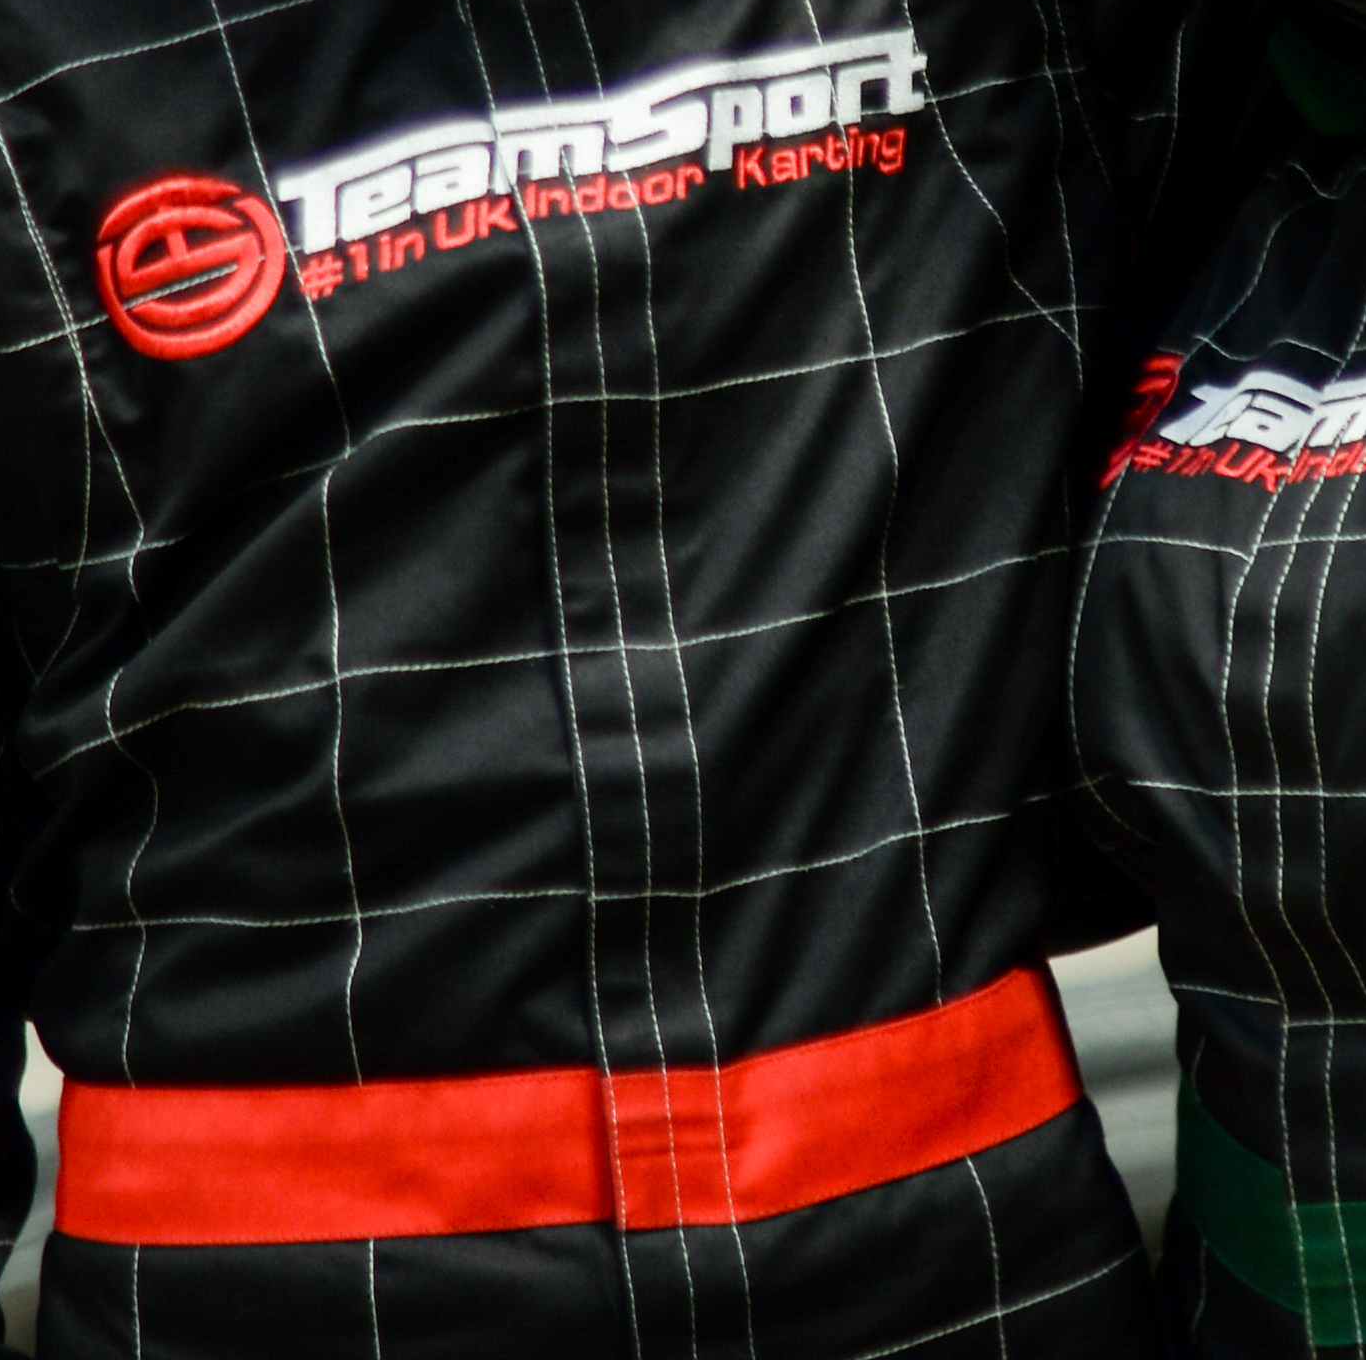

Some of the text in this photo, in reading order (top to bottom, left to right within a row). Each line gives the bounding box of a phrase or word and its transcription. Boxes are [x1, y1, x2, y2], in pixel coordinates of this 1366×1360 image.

[278, 30, 928, 255] TeamSport
[435, 194, 518, 251] UK
[523, 162, 706, 219] Indoor
[737, 126, 907, 190] Karting
[1213, 440, 1288, 494] UK
